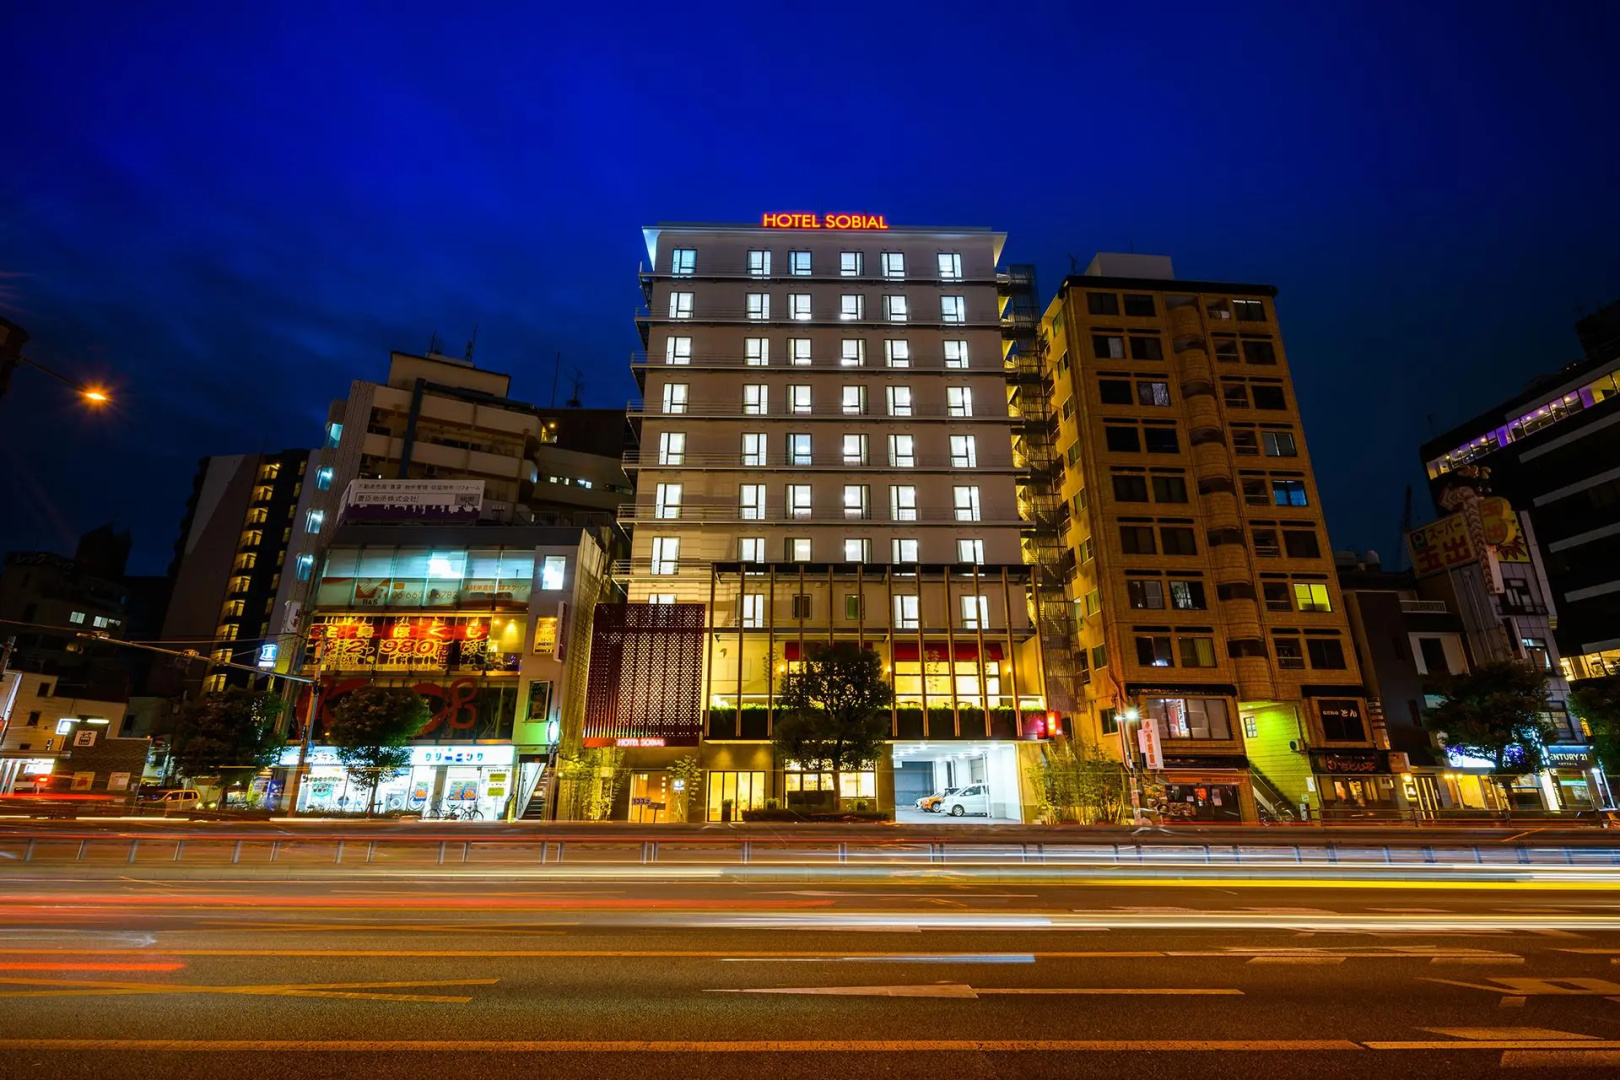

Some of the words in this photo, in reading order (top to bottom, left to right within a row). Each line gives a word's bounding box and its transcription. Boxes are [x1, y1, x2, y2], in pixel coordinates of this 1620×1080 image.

[763, 213, 821, 228] HOTEL
[825, 214, 889, 229] SOBIAL
[1428, 520, 1463, 541] スーパー
[1414, 535, 1472, 574] 玉出
[616, 738, 639, 747] HOTEL
[639, 738, 665, 747] SOBIAL
[1579, 753, 1588, 761] 21
